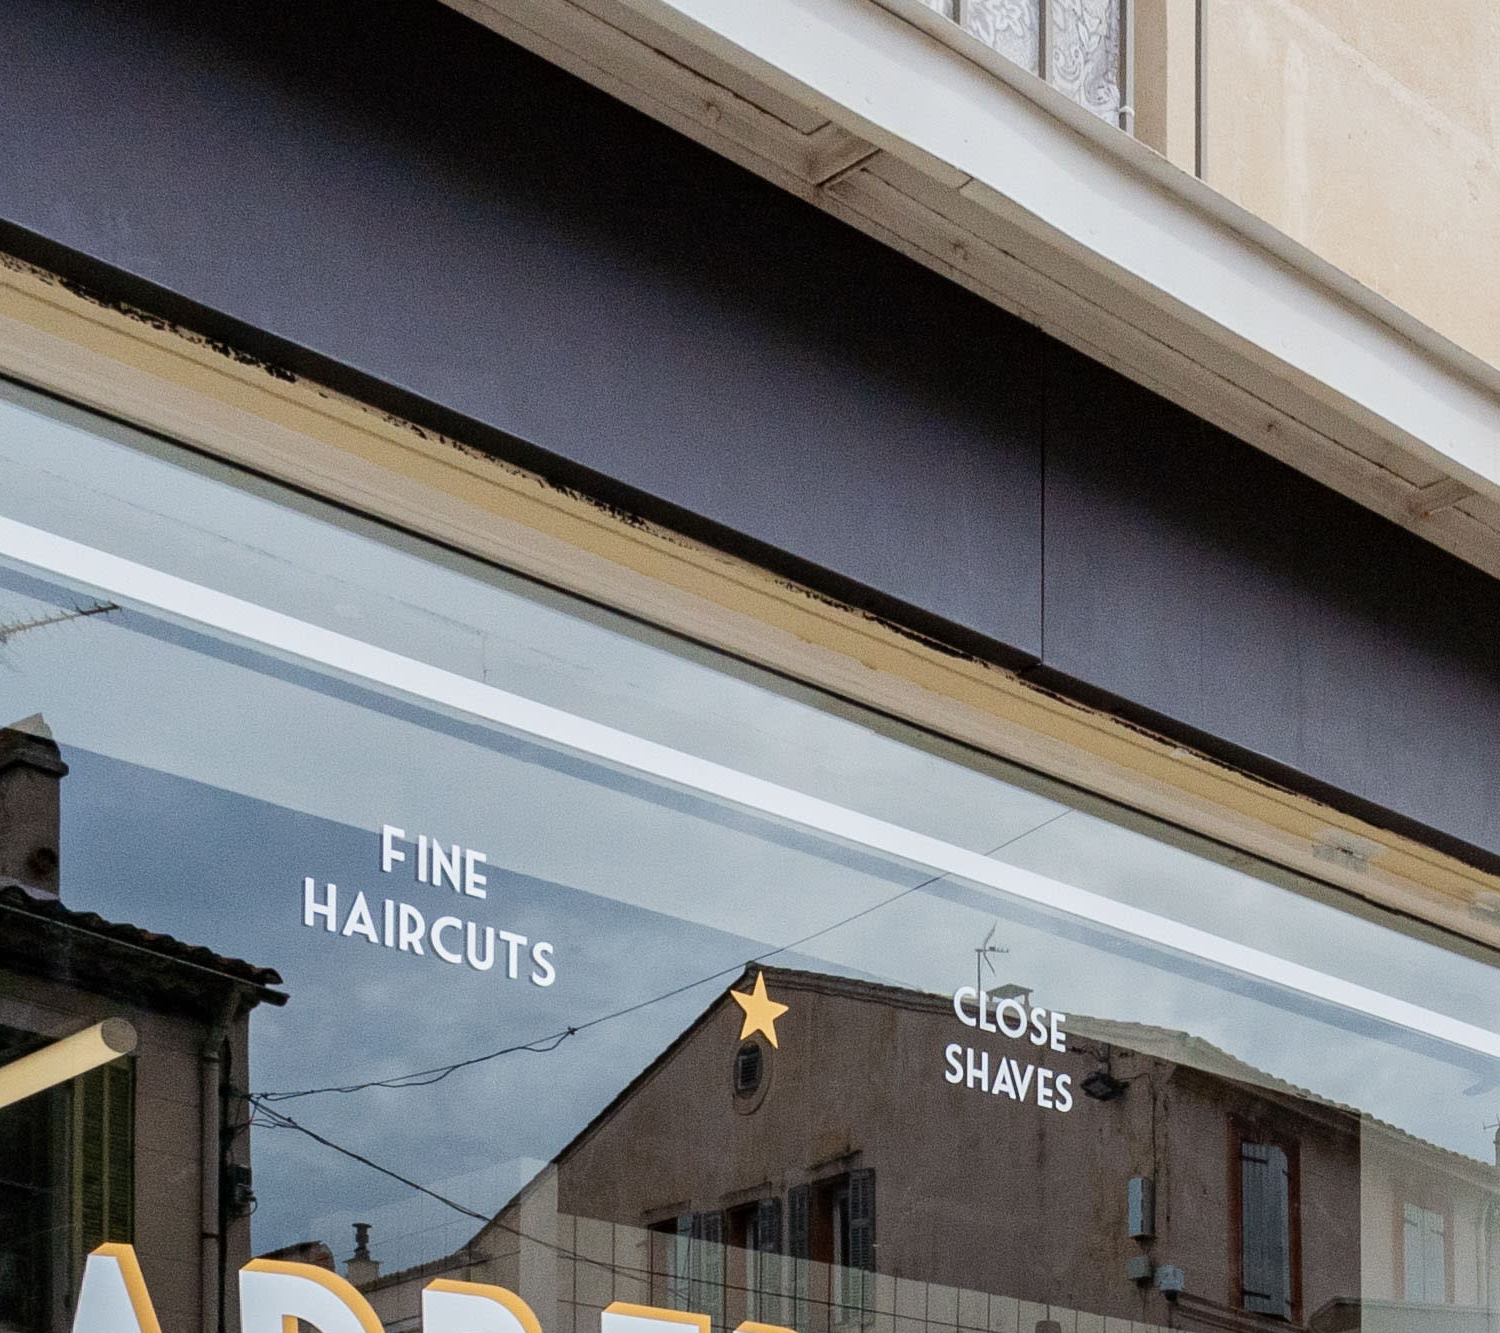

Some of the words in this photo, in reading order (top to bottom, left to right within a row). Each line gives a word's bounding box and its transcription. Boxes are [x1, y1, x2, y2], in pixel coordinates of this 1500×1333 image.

[382, 822, 489, 900] FINE
[304, 876, 557, 987] HAIRCUTS
[952, 986, 1067, 1053] CLOSE
[945, 1043, 1073, 1112] SHAVES
